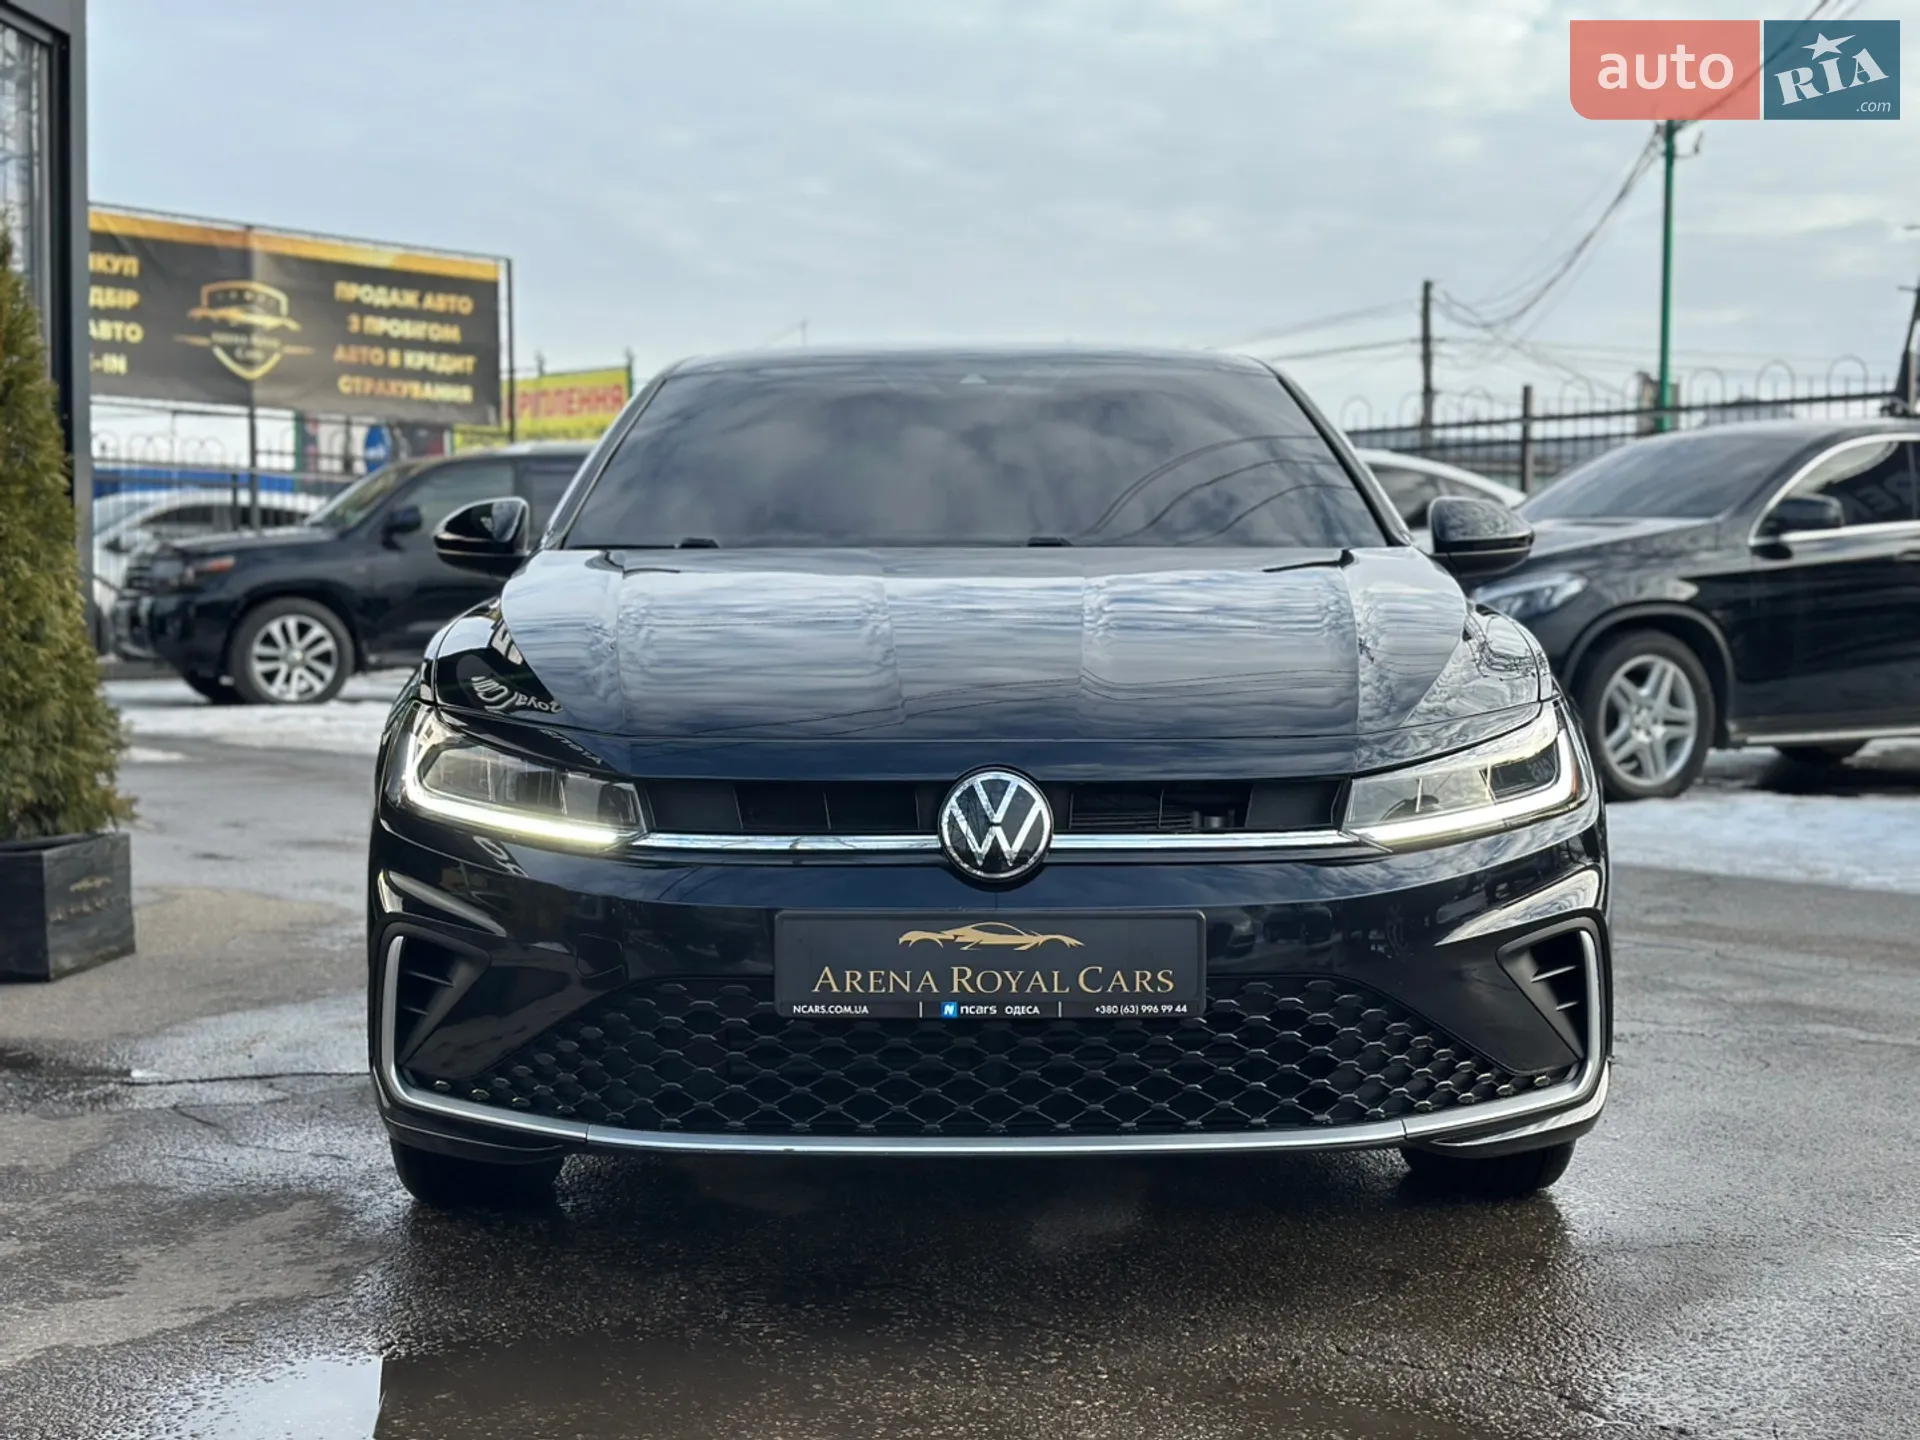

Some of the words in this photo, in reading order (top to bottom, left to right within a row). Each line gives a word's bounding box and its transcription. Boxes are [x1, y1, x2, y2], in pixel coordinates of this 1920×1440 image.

[334, 280, 420, 309] ПРОДАЖ
[422, 291, 474, 316] АВТО
[363, 314, 462, 344] ПРОБІГОМ
[333, 344, 385, 367] АВТО
[404, 349, 477, 376] КРЕДИТ
[337, 374, 474, 404] СТРАХУВАННЯ
[507, 384, 624, 420] РІПЛЕННЯ
[812, 965, 940, 994] ARENA
[950, 965, 1070, 994] ROYAL
[1078, 965, 1175, 994] CARS
[793, 1004, 869, 1015] NCARS.COM.UA
[960, 1004, 997, 1015] ncars
[1005, 1005, 1040, 1016] ОДЕСА
[1095, 1004, 1118, 1015] +380
[1120, 1004, 1139, 1016] (63)
[1141, 1004, 1159, 1014] 996
[1161, 1004, 1173, 1014] 99
[1175, 1004, 1188, 1014] 44
